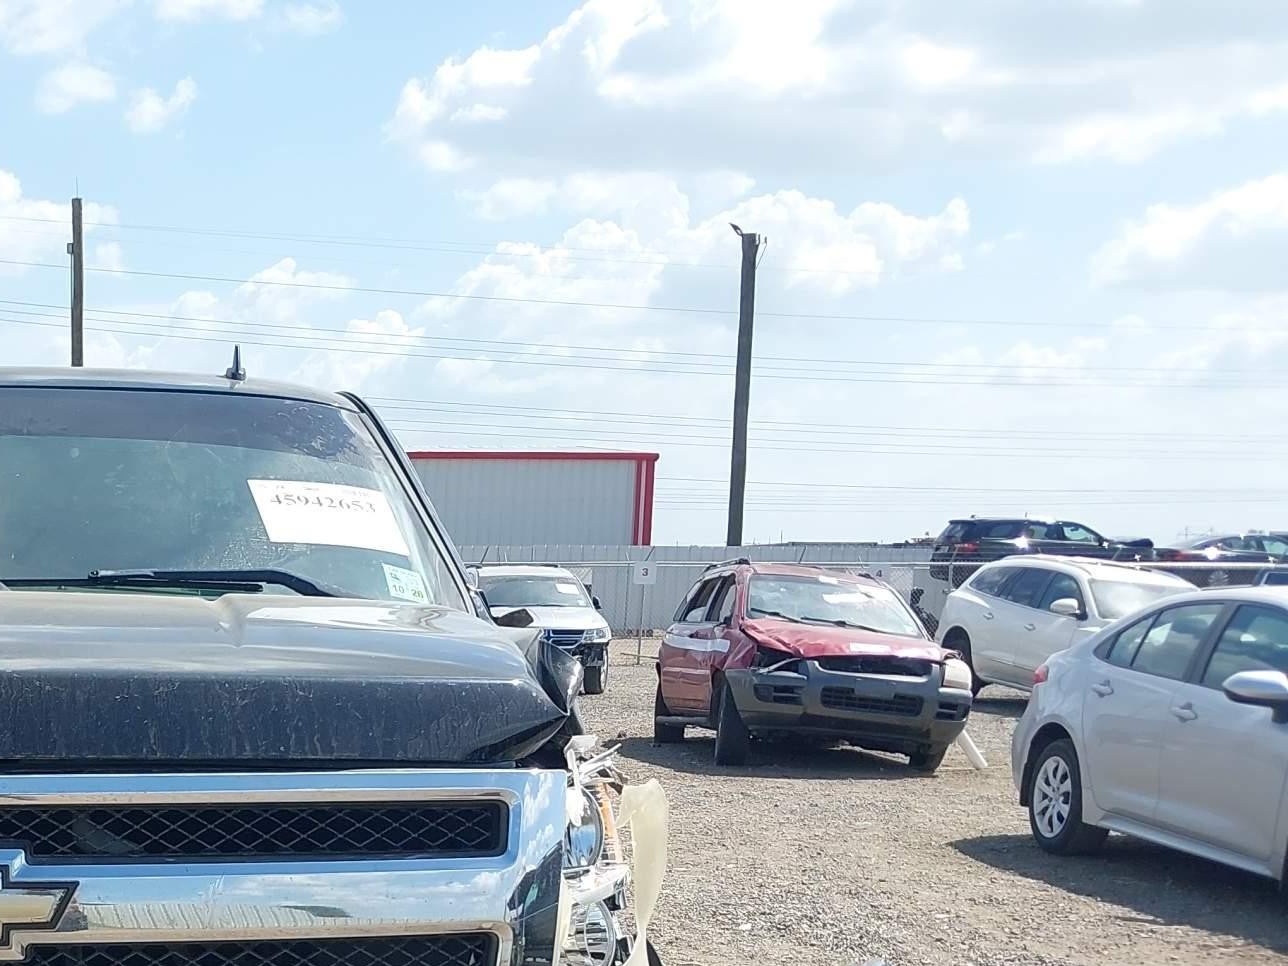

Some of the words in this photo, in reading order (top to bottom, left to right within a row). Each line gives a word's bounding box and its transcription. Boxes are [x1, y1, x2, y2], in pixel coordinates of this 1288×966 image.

[271, 494, 376, 512] 45942653
[641, 567, 649, 577] 3
[875, 569, 883, 578] 4
